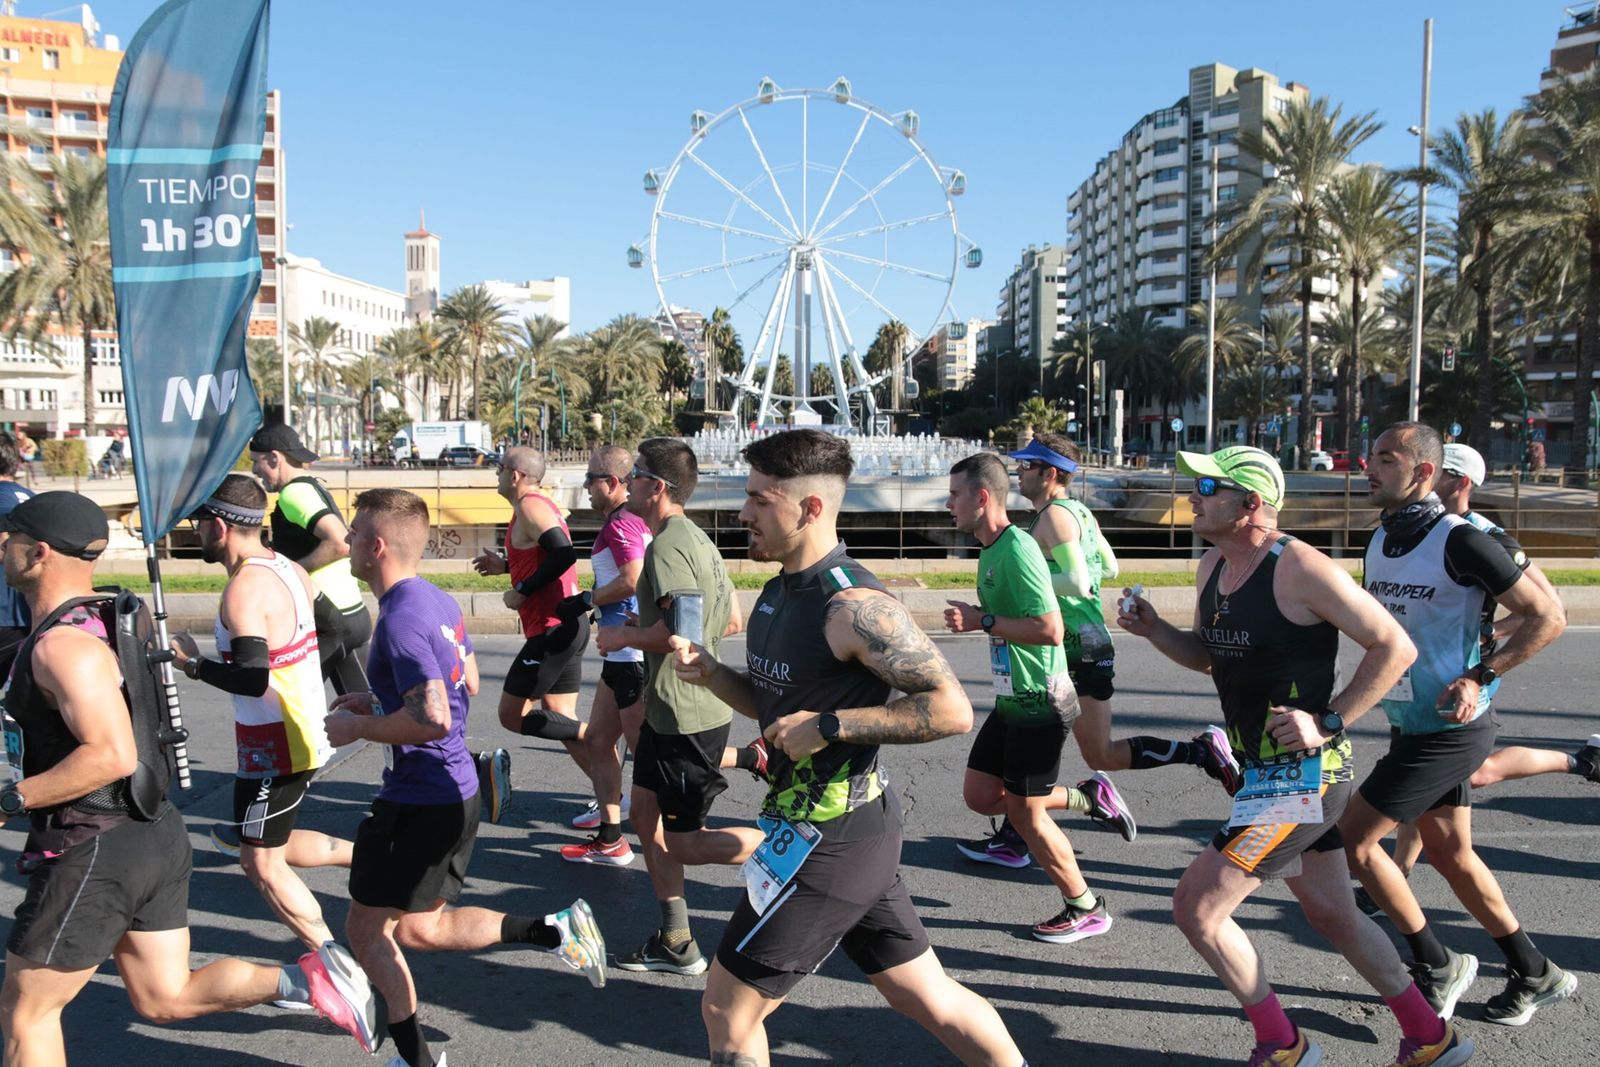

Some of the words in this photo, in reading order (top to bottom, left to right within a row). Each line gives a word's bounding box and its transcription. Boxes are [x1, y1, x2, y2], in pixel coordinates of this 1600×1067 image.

[138, 174, 251, 204] TIEMPO
[140, 218, 187, 252] 1h
[1368, 580, 1436, 601] ANTIGRUPETA
